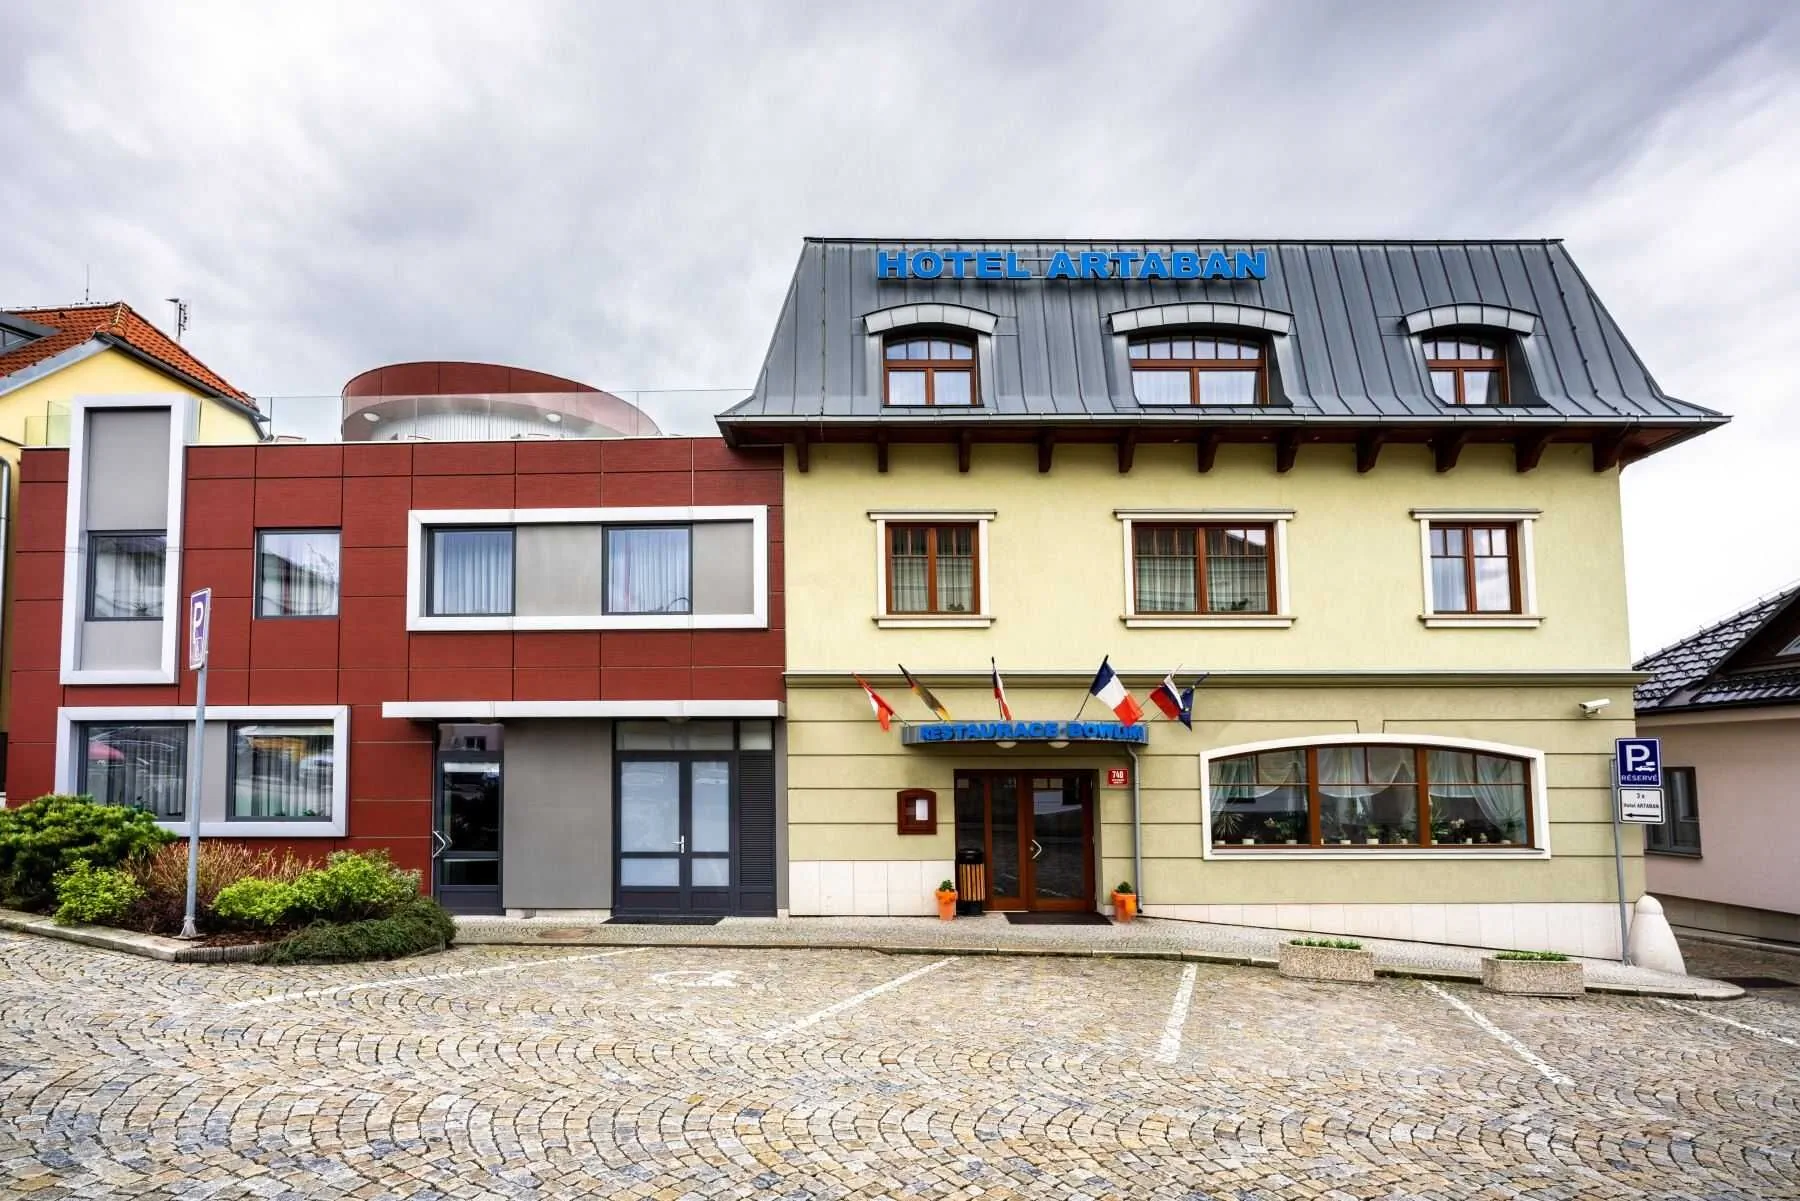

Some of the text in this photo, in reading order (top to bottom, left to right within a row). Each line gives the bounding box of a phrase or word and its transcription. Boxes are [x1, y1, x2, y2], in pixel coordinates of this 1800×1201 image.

[877, 251, 1267, 280] HOTEL ARTABAN
[193, 601, 204, 644] P
[920, 722, 1058, 740] RESTAURACE
[1625, 744, 1650, 772] P
